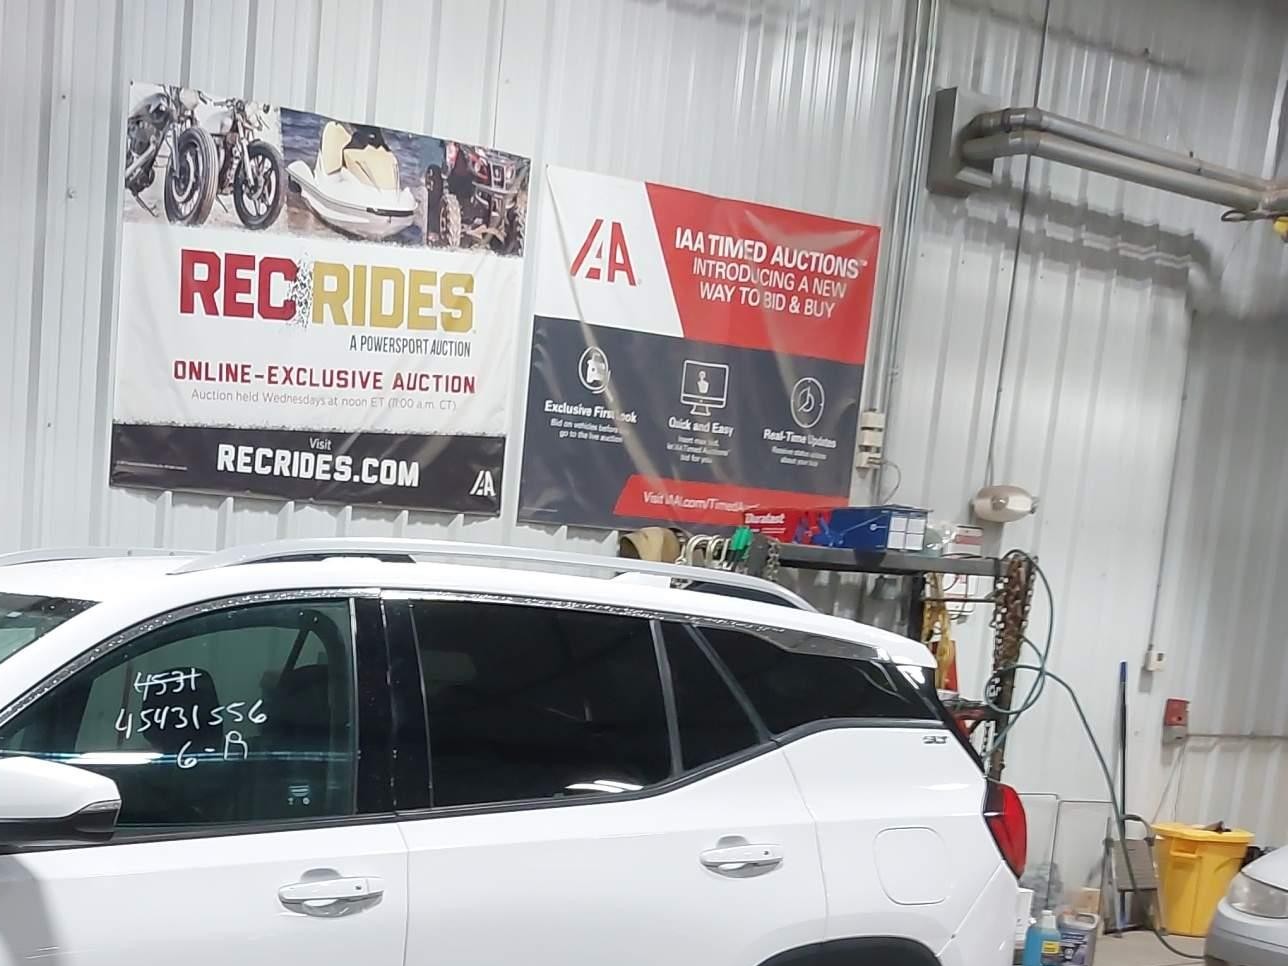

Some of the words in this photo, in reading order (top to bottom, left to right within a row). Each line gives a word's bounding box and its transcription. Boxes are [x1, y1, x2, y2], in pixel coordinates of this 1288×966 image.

[675, 226, 705, 253] IAA
[708, 234, 768, 263] TIMED
[180, 248, 299, 321] REC
[312, 260, 475, 334] RIDES
[692, 258, 795, 292] INTRODUCING
[798, 277, 810, 293] A
[813, 279, 848, 299] NEW
[699, 281, 733, 302] WAY
[739, 286, 761, 306] TO
[764, 290, 785, 312] BID
[789, 298, 801, 314] &
[804, 299, 836, 319] BUY
[349, 335, 358, 353] A
[360, 335, 429, 356] POWERSPORT
[430, 338, 472, 358] AUCTION
[173, 360, 384, 391] ONLINE-EXCLUSIVE
[392, 372, 476, 394] AUCTION
[191, 388, 233, 401] Auction
[235, 391, 259, 403] held
[263, 392, 326, 408] Wednesdays
[341, 398, 367, 407] noon
[544, 400, 592, 417] Exclusive
[668, 416, 692, 431] Quick
[692, 422, 711, 433] and
[711, 422, 735, 438] Easy
[763, 428, 807, 445] Real-Time
[309, 437, 331, 451] Visit
[216, 443, 420, 488] RECRIDES.COM
